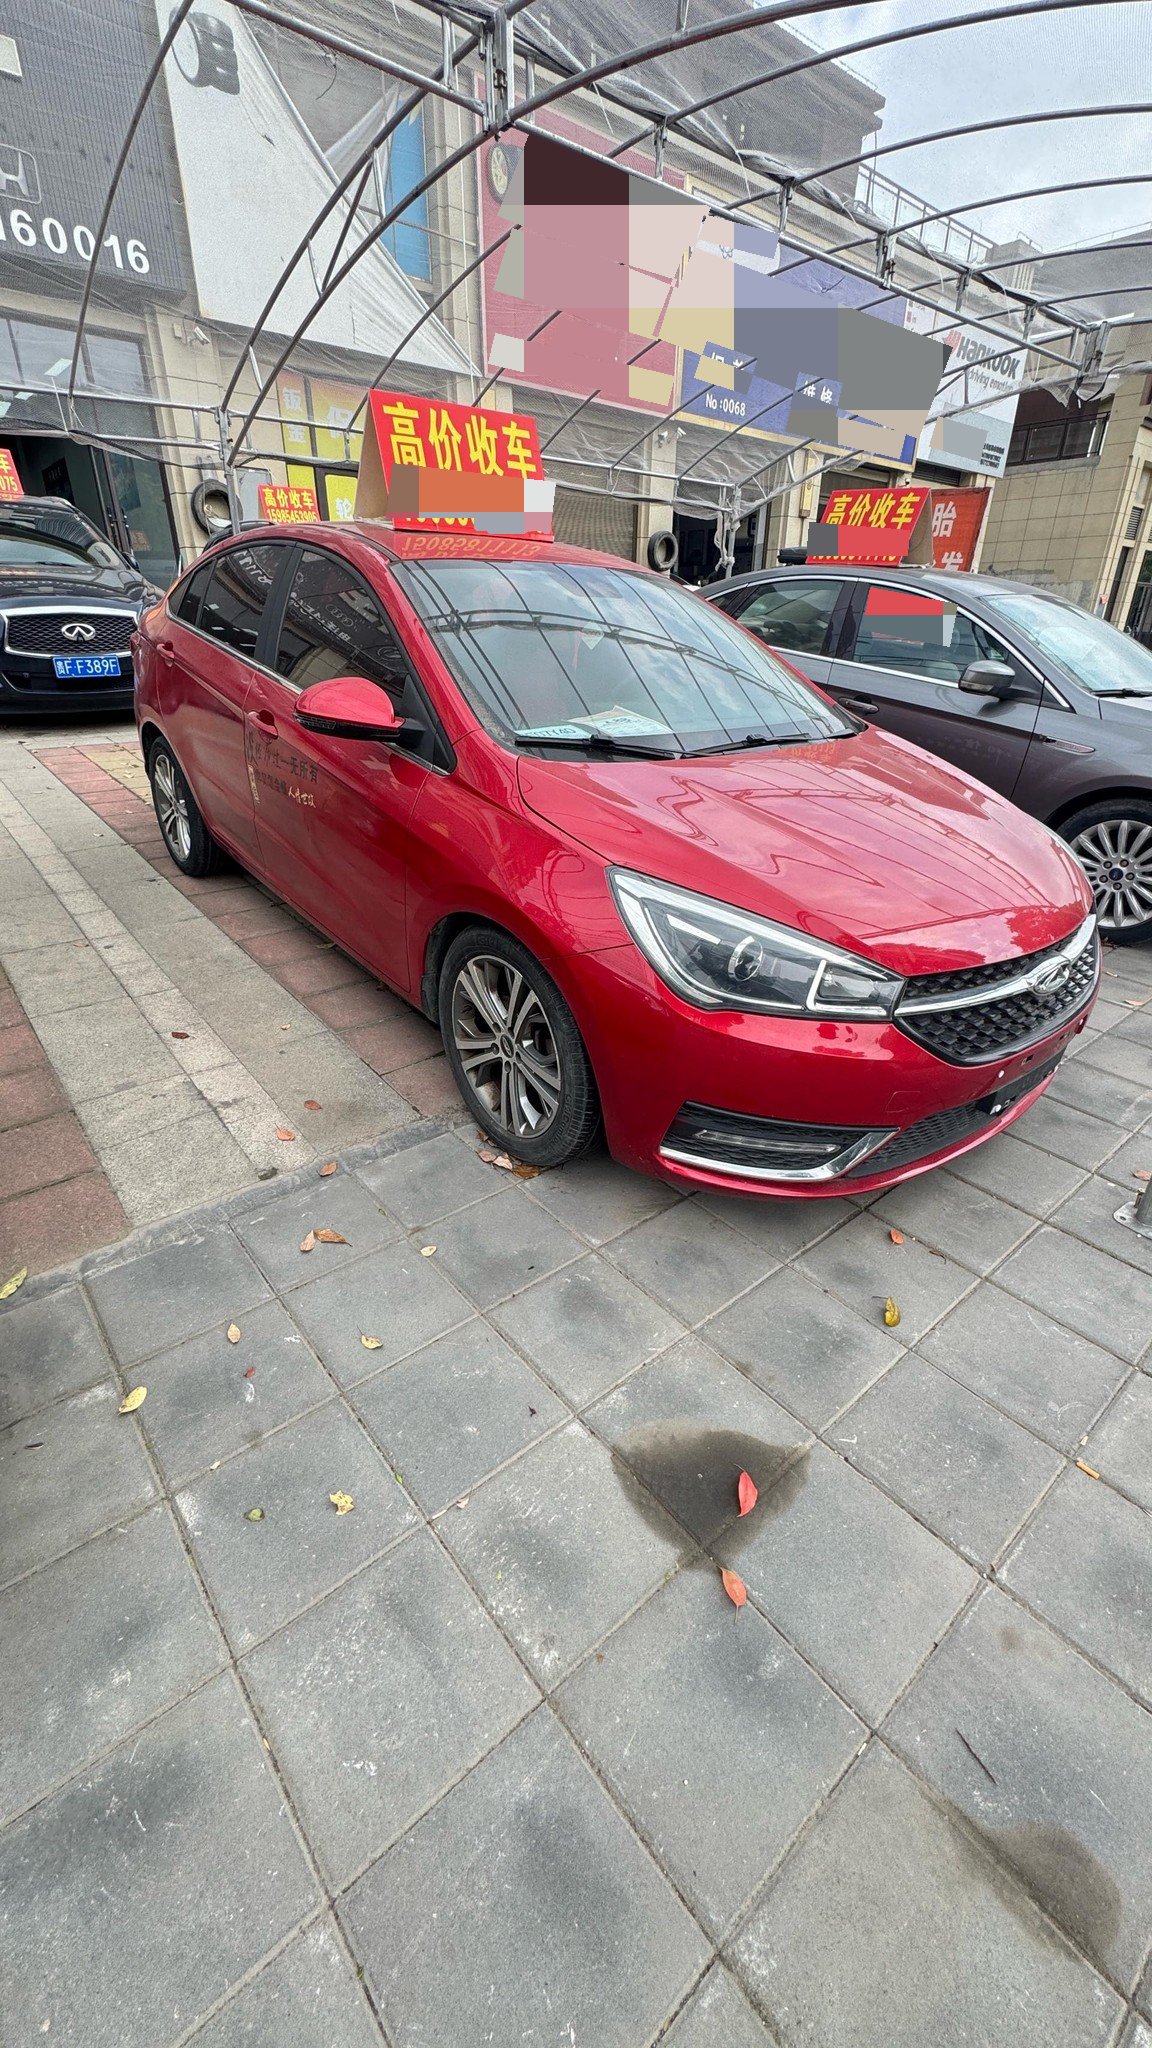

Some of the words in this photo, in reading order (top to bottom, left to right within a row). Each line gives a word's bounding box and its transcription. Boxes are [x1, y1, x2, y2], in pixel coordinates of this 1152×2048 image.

[0, 208, 150, 274] 60016
[382, 401, 537, 479] 高价收车
[262, 486, 315, 510] 高价收车
[826, 491, 921, 529] 高价收车
[932, 501, 957, 538] 胎
